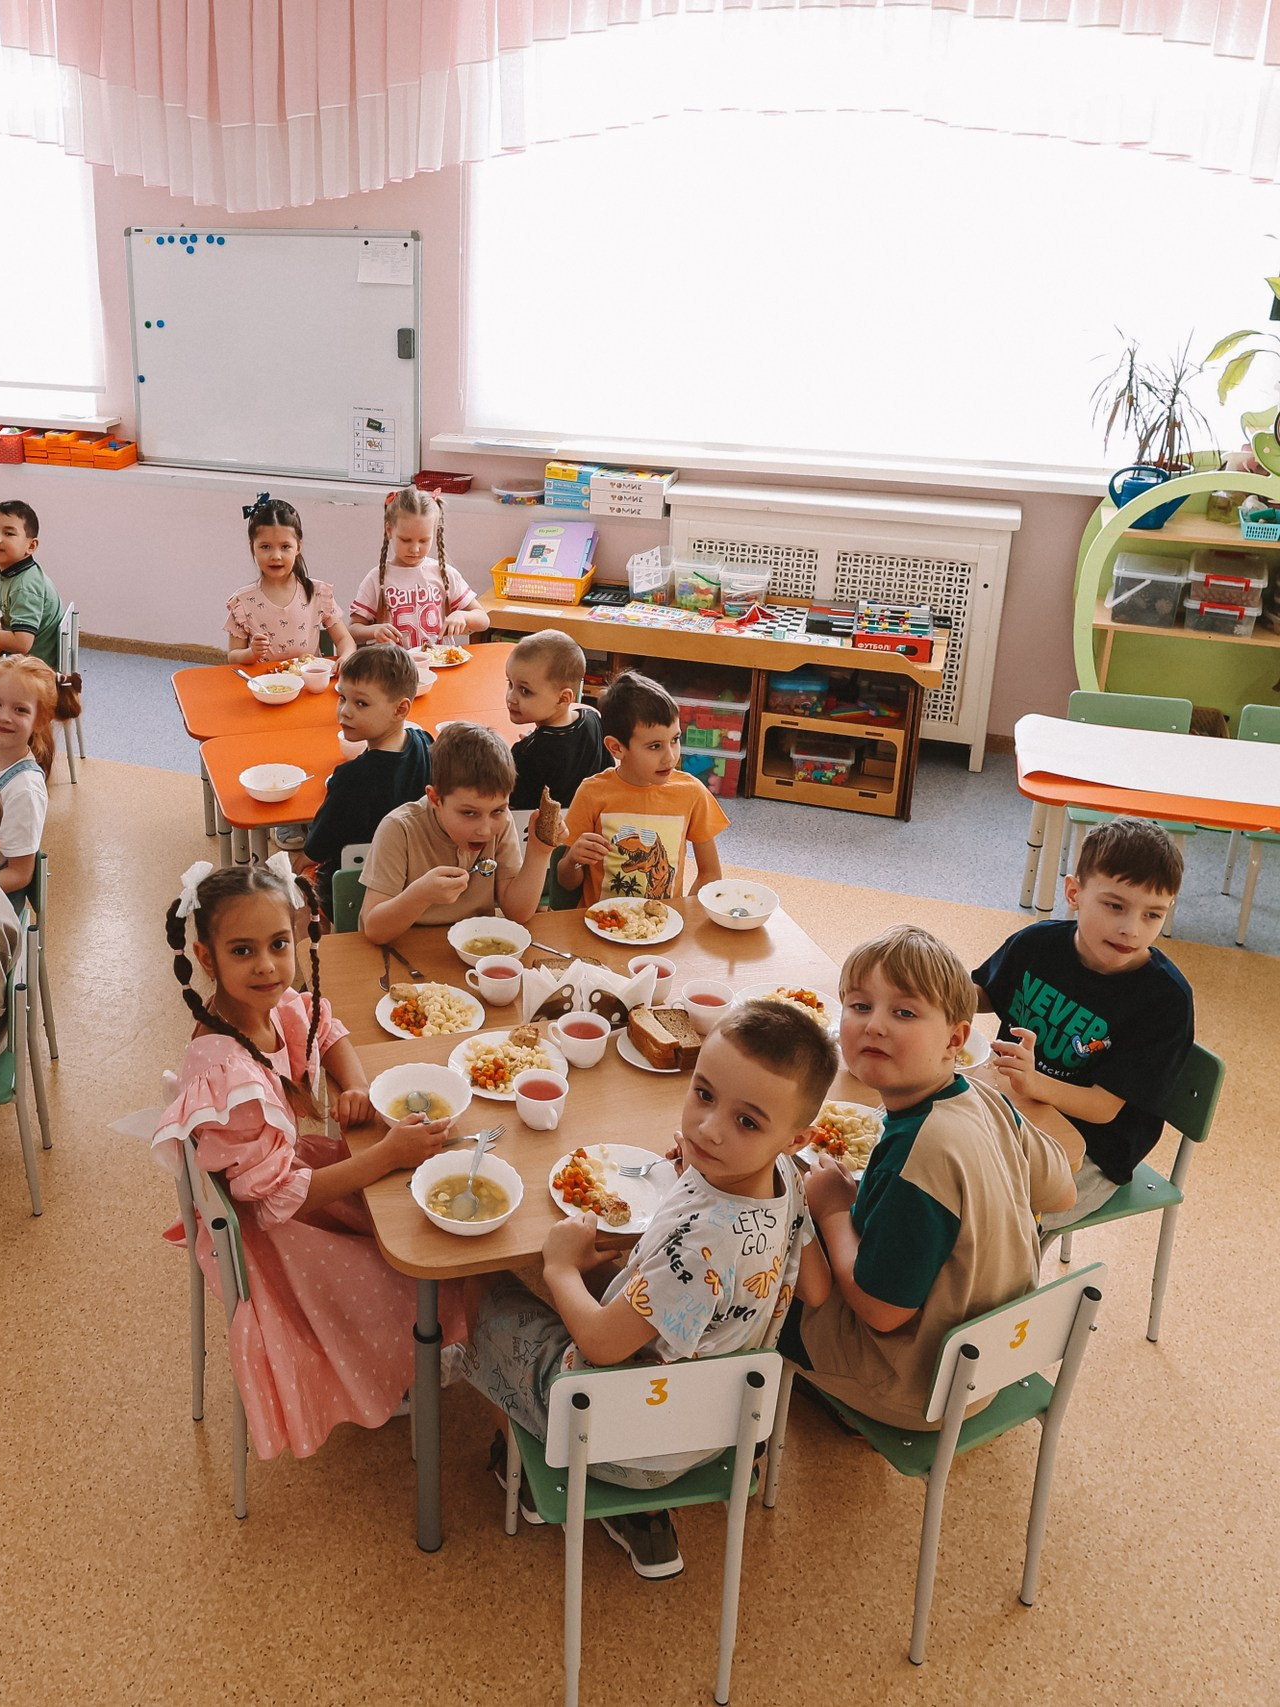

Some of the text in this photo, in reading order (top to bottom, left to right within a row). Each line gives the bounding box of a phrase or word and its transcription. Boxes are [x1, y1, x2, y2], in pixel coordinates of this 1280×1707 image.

[385, 584, 441, 608] Barbie
[1023, 970, 1108, 1043] NEVER
[732, 1208, 777, 1234] LET'S
[1009, 1319, 1029, 1349] 3
[645, 1378, 668, 1405] 3
